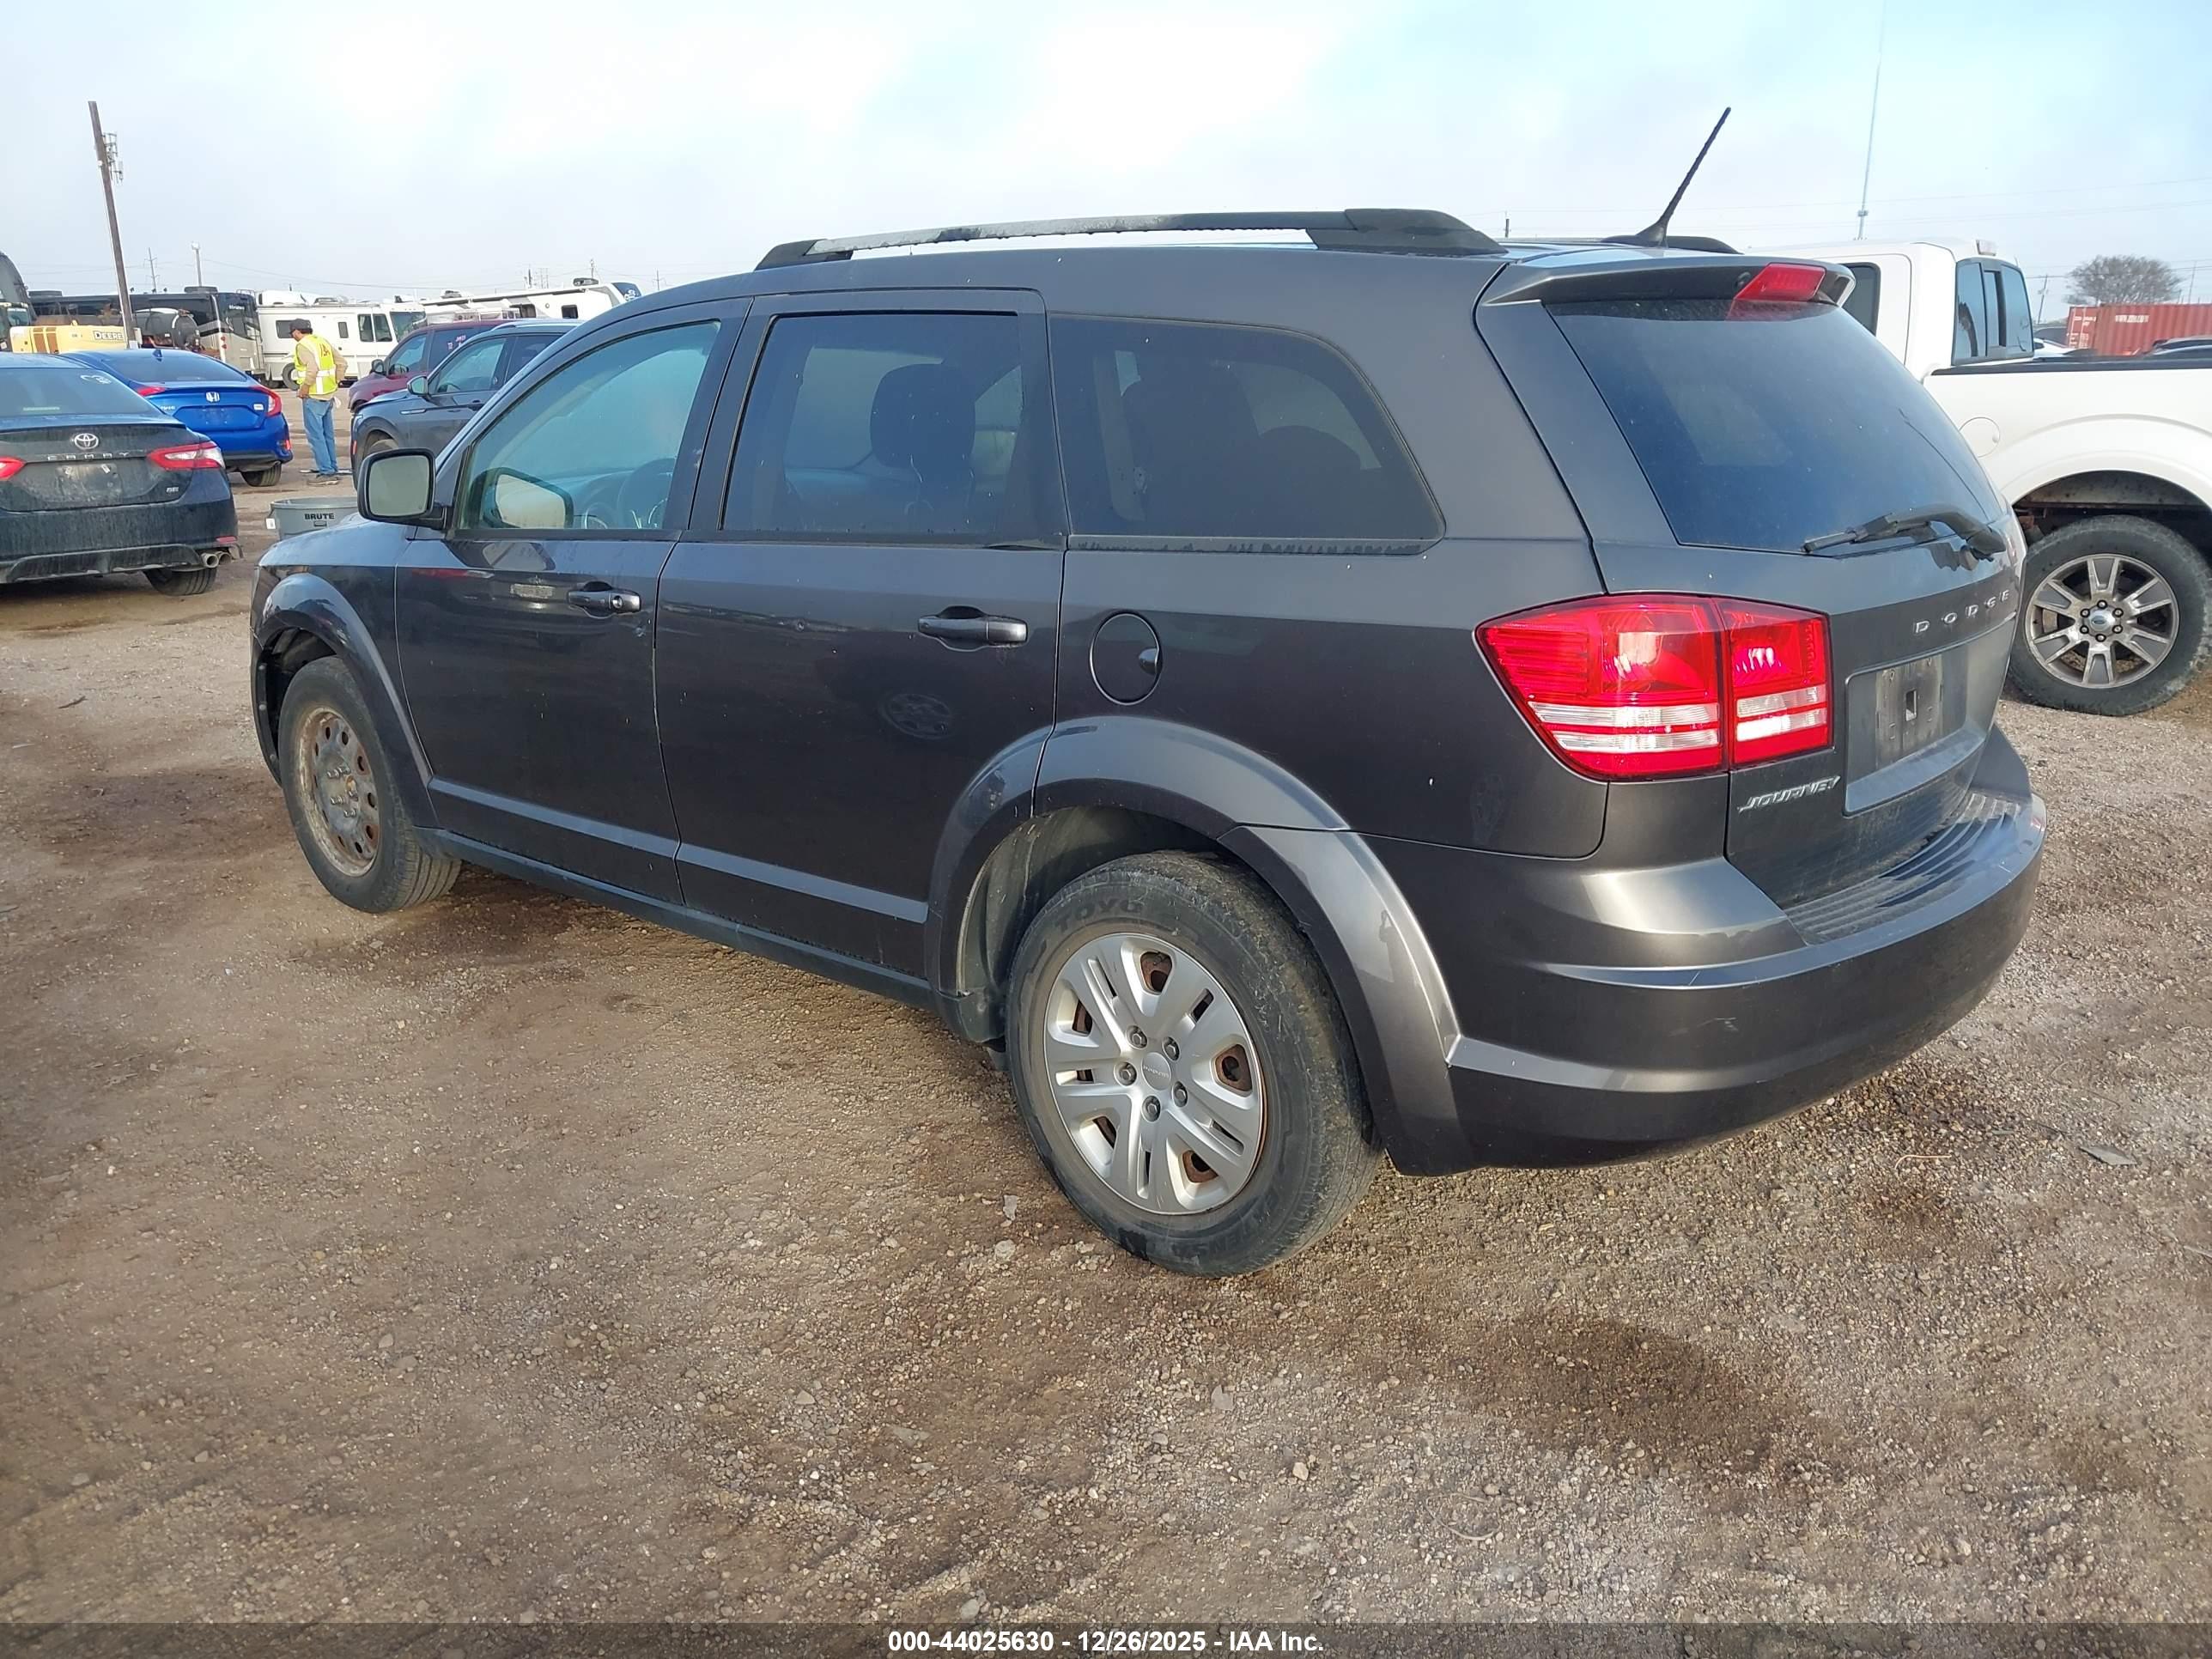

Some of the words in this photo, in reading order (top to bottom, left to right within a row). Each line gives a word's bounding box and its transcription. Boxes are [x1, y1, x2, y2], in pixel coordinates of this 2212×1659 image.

[94, 330, 125, 341] DEERE
[47, 452, 129, 461] CAMRY
[1911, 589, 2010, 634] DODGE
[1736, 775, 1841, 814] JOURNEY
